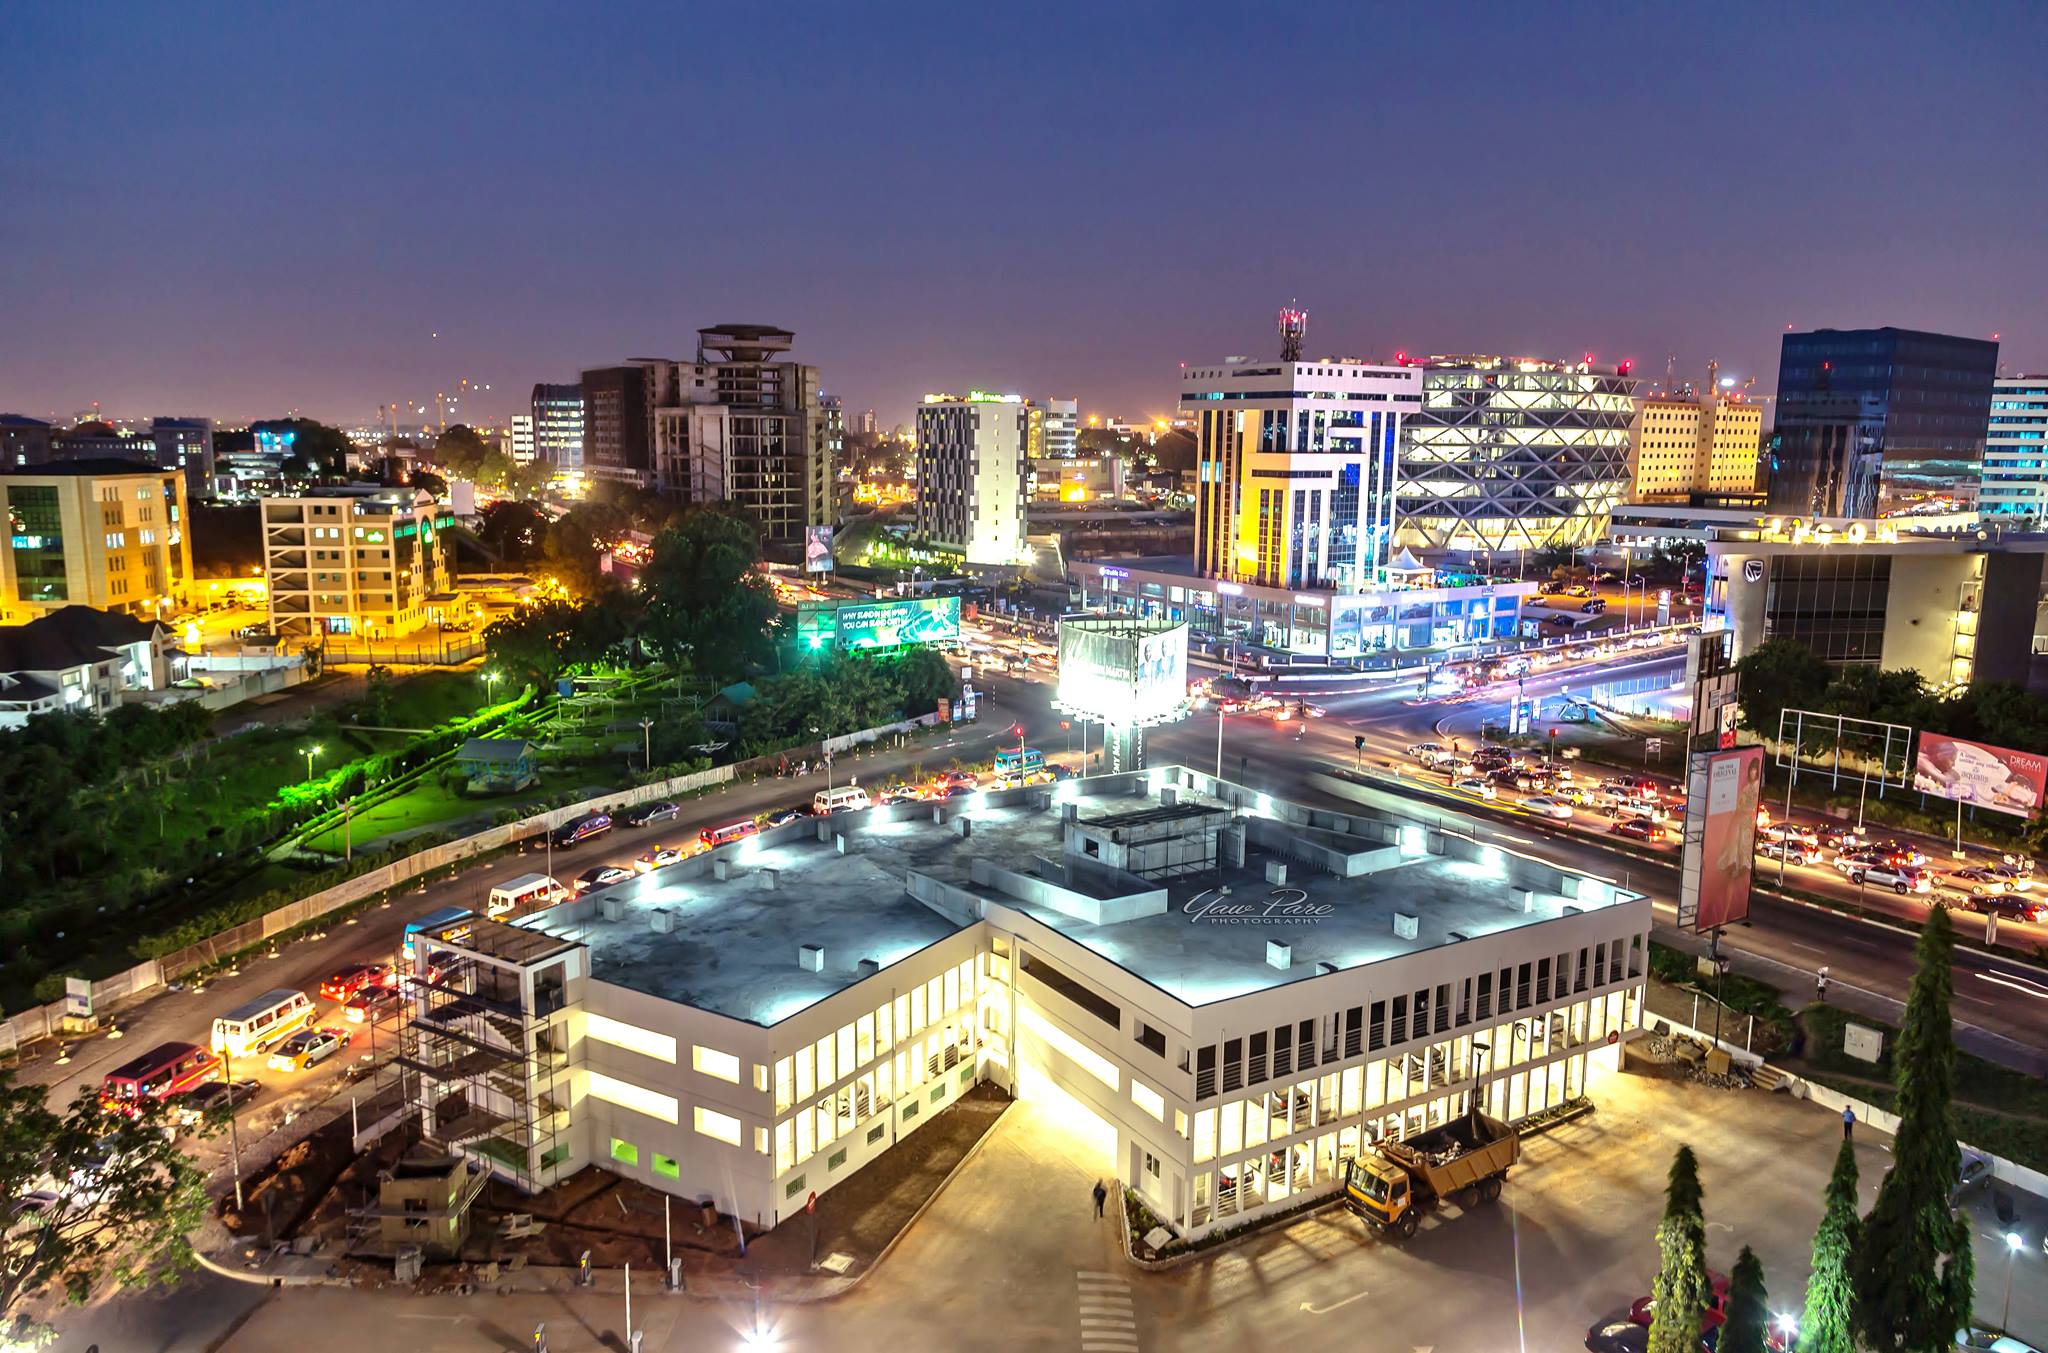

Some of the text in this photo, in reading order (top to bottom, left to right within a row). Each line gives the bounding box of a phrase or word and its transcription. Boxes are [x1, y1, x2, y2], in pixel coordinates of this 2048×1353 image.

[843, 612, 857, 620] WHY
[843, 621, 855, 630] YOU
[856, 621, 868, 629] CAN
[2010, 755, 2041, 772] DREAM
